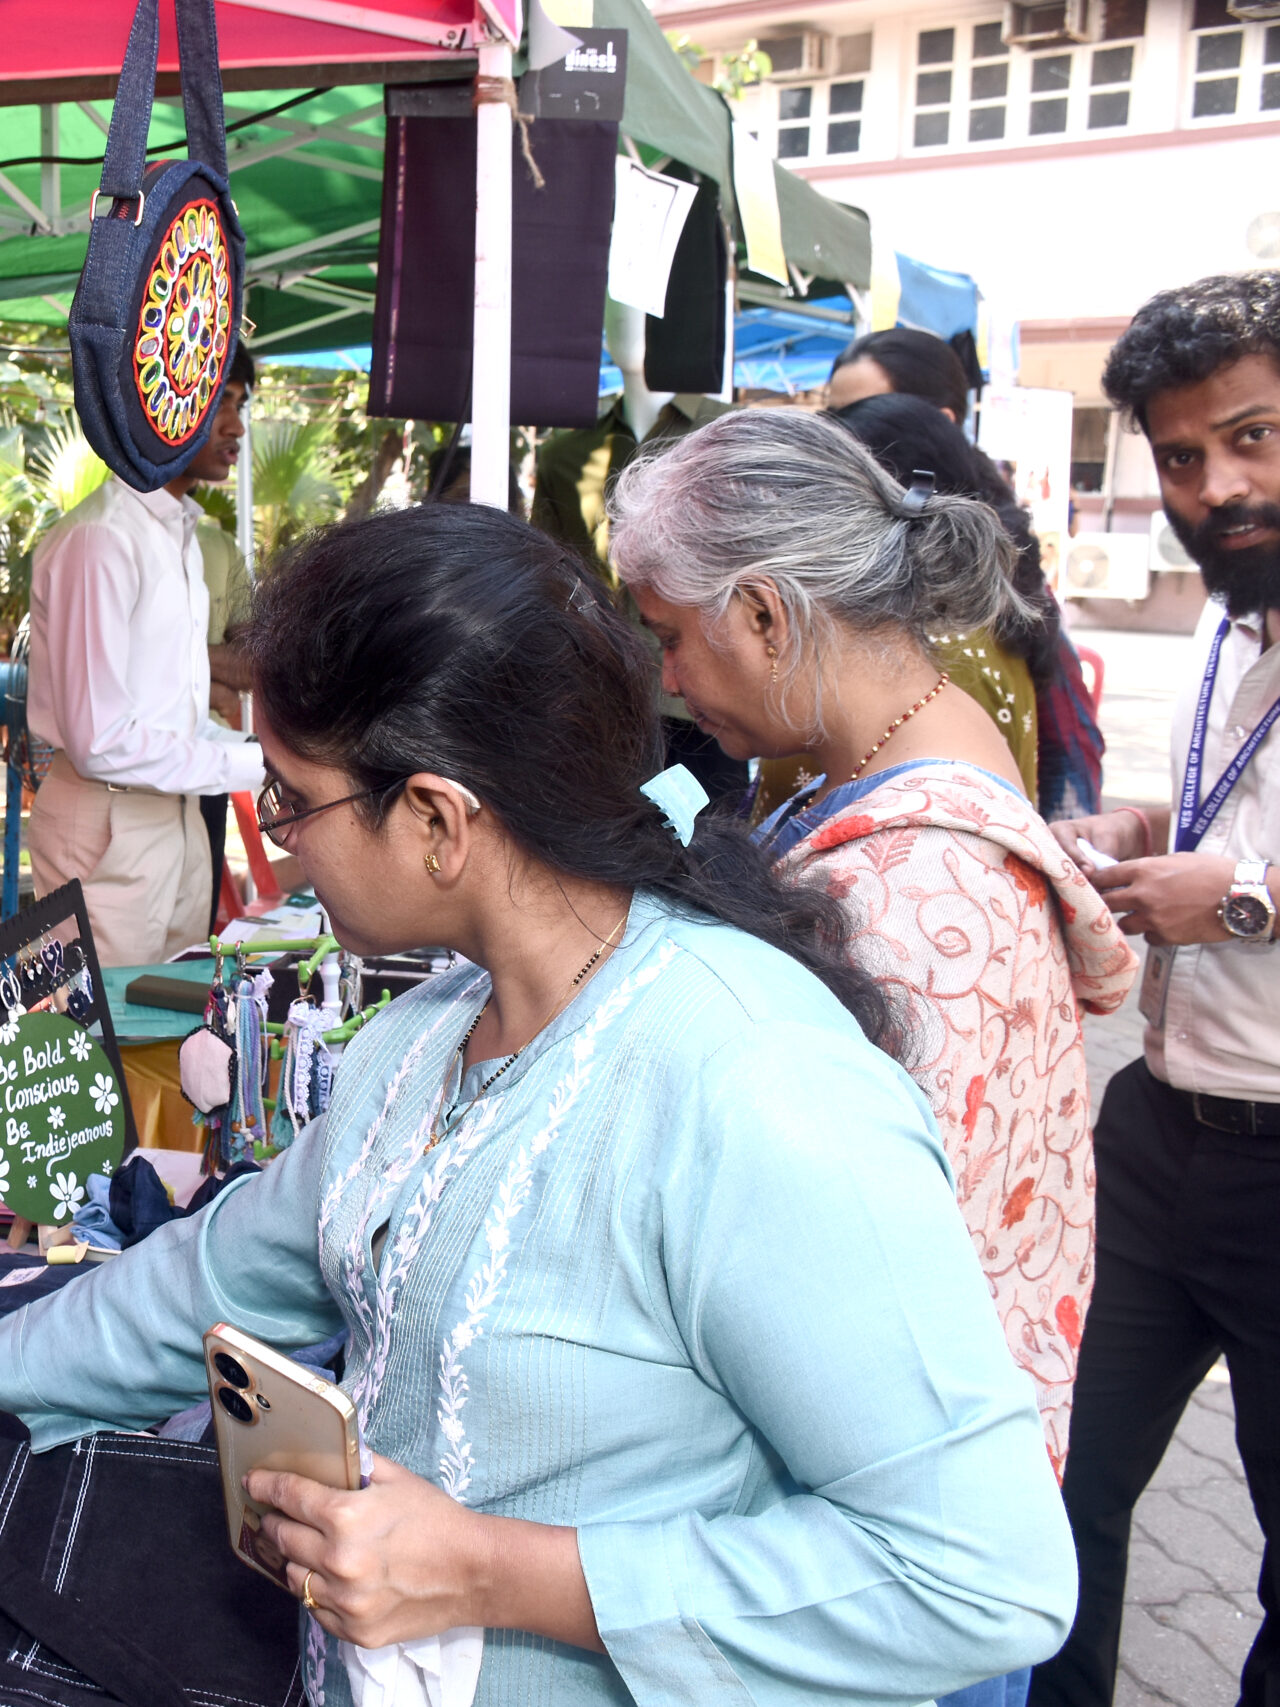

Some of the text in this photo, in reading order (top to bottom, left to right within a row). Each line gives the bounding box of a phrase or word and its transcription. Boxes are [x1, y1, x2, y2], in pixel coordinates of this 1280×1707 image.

[1191, 680, 1212, 749] ARCHITECTURE
[1189, 752, 1200, 764] OF
[1182, 766, 1198, 807] COLLEGE
[1192, 818, 1208, 835] VES
[1203, 780, 1231, 818] COLLEGE
[1226, 764, 1238, 781] OF
[1180, 810, 1194, 829] VES
[23, 1039, 65, 1077] Bold
[5, 1073, 80, 1113] Conscious
[6, 1117, 31, 1146] Be
[20, 1120, 113, 1177] Indiejeanous
